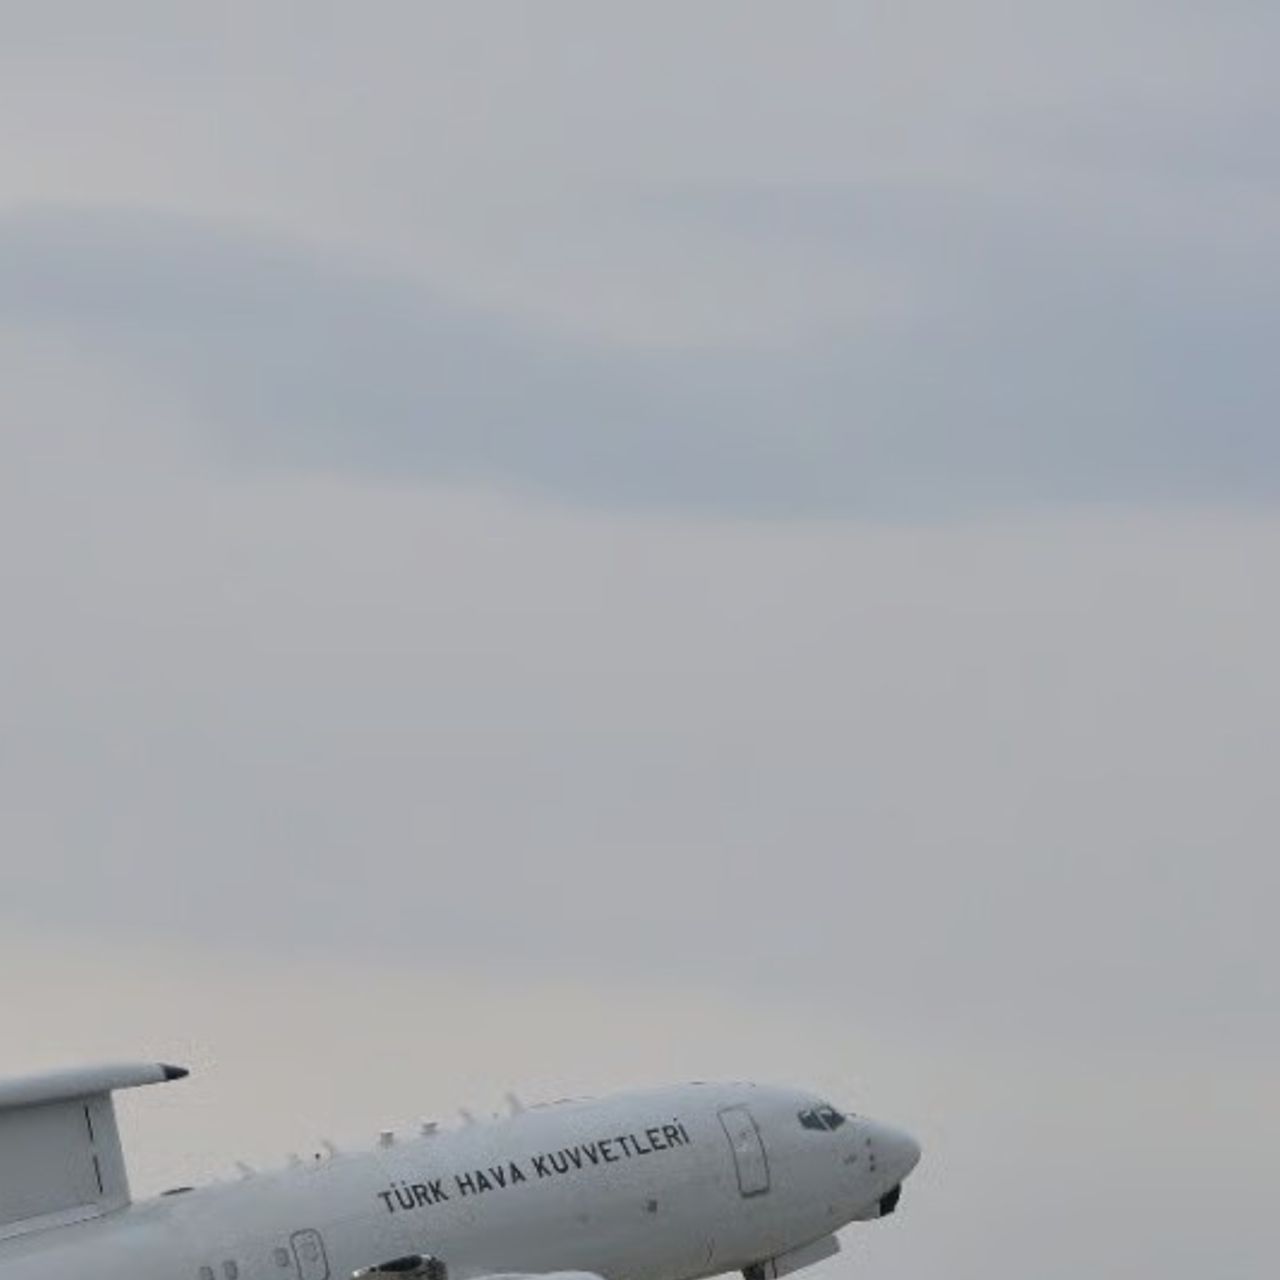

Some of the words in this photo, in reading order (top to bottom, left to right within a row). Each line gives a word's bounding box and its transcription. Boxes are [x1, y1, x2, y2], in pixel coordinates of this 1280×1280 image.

[377, 1179, 450, 1213] TÜRK
[454, 1163, 526, 1196] HAVA
[531, 1118, 690, 1178] KUVVETLERİ
